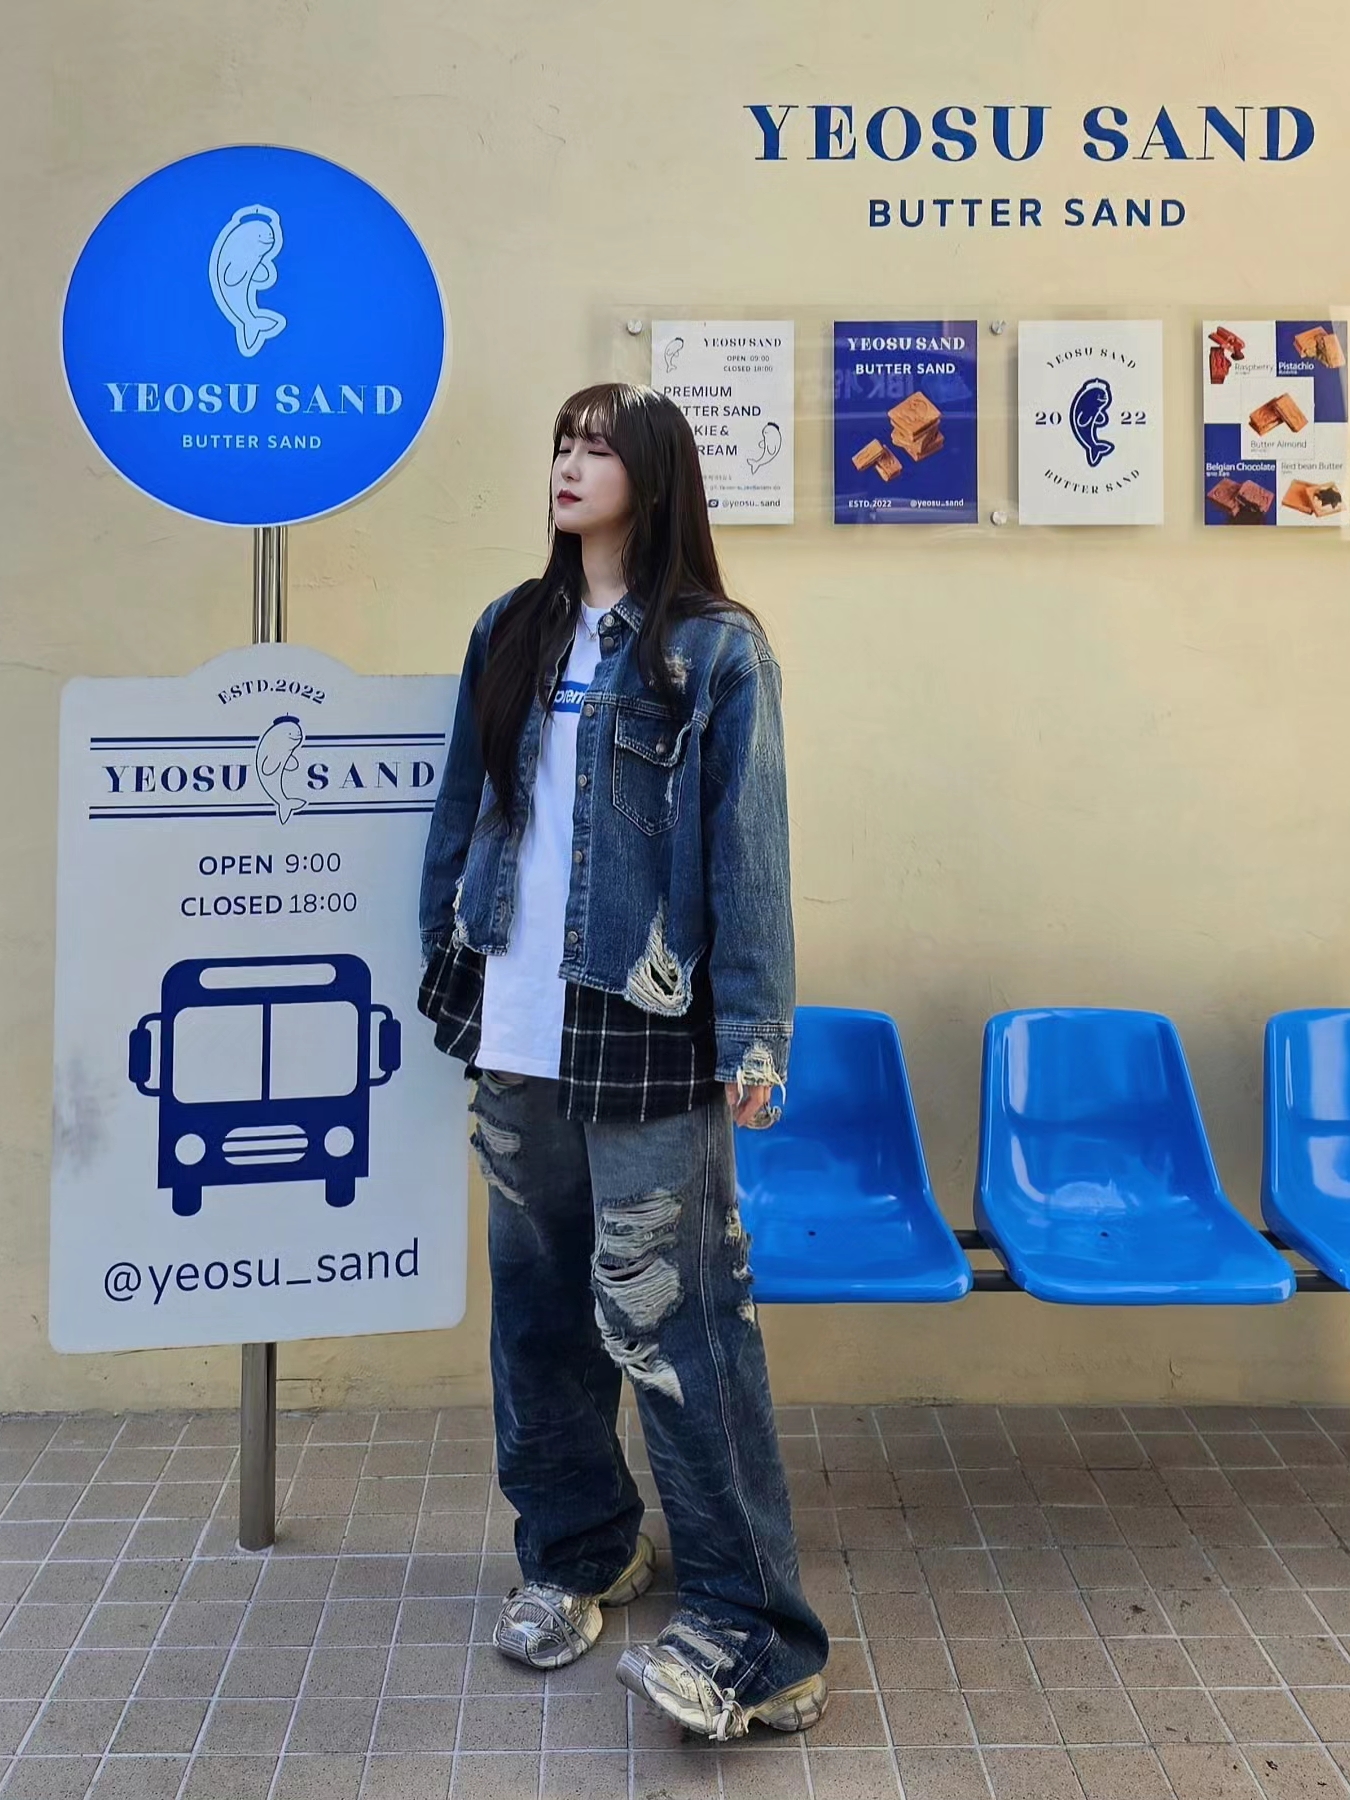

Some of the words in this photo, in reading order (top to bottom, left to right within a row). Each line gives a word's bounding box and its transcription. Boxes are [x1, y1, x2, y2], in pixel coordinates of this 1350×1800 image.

[742, 104, 1053, 162] YEOSU
[1083, 105, 1314, 161] SAND
[870, 199, 1041, 227] BUTTER
[1065, 198, 1185, 226] SAND
[704, 338, 745, 347] YEOSU
[749, 339, 781, 347] SAND
[848, 337, 911, 350] YEOSU
[916, 336, 965, 350] SAND
[1047, 348, 1092, 368] YEOSU
[1101, 349, 1135, 368] SAND
[856, 364, 911, 374] BUTTER
[917, 363, 955, 374] SAND
[1278, 361, 1314, 370] Pistachio
[663, 386, 732, 397] PREMIUM
[104, 383, 260, 413] YEOSU
[276, 384, 403, 416] SAND
[682, 406, 719, 417] TTER
[724, 406, 761, 416] SAND
[1036, 412, 1061, 425] 20
[1121, 412, 1146, 424] 22
[720, 425, 728, 435] &
[182, 435, 259, 448] BUTTER
[268, 435, 322, 448] SAND
[1250, 440, 1274, 449] Butter
[1277, 440, 1307, 449] Almond
[698, 445, 738, 456] REAM
[1206, 462, 1235, 472] Belgian
[1236, 462, 1275, 471] Chocolate
[1281, 462, 1297, 471] Red
[1299, 462, 1317, 471] bean
[1319, 462, 1343, 471] Butter
[1045, 470, 1098, 493] BUTTER
[1106, 470, 1139, 492] SAND
[848, 500, 892, 508] ESTD.2022
[909, 499, 964, 509] @yeosu_sand
[218, 680, 325, 704] ESTD.2022
[102, 764, 250, 793] YEOSU
[308, 761, 434, 789] SAND
[199, 855, 272, 875] OPEN
[286, 853, 340, 873] 9:00
[181, 895, 282, 916] CLOSED
[289, 893, 356, 913] 18:00
[105, 1237, 418, 1305] @yeosu_sand
